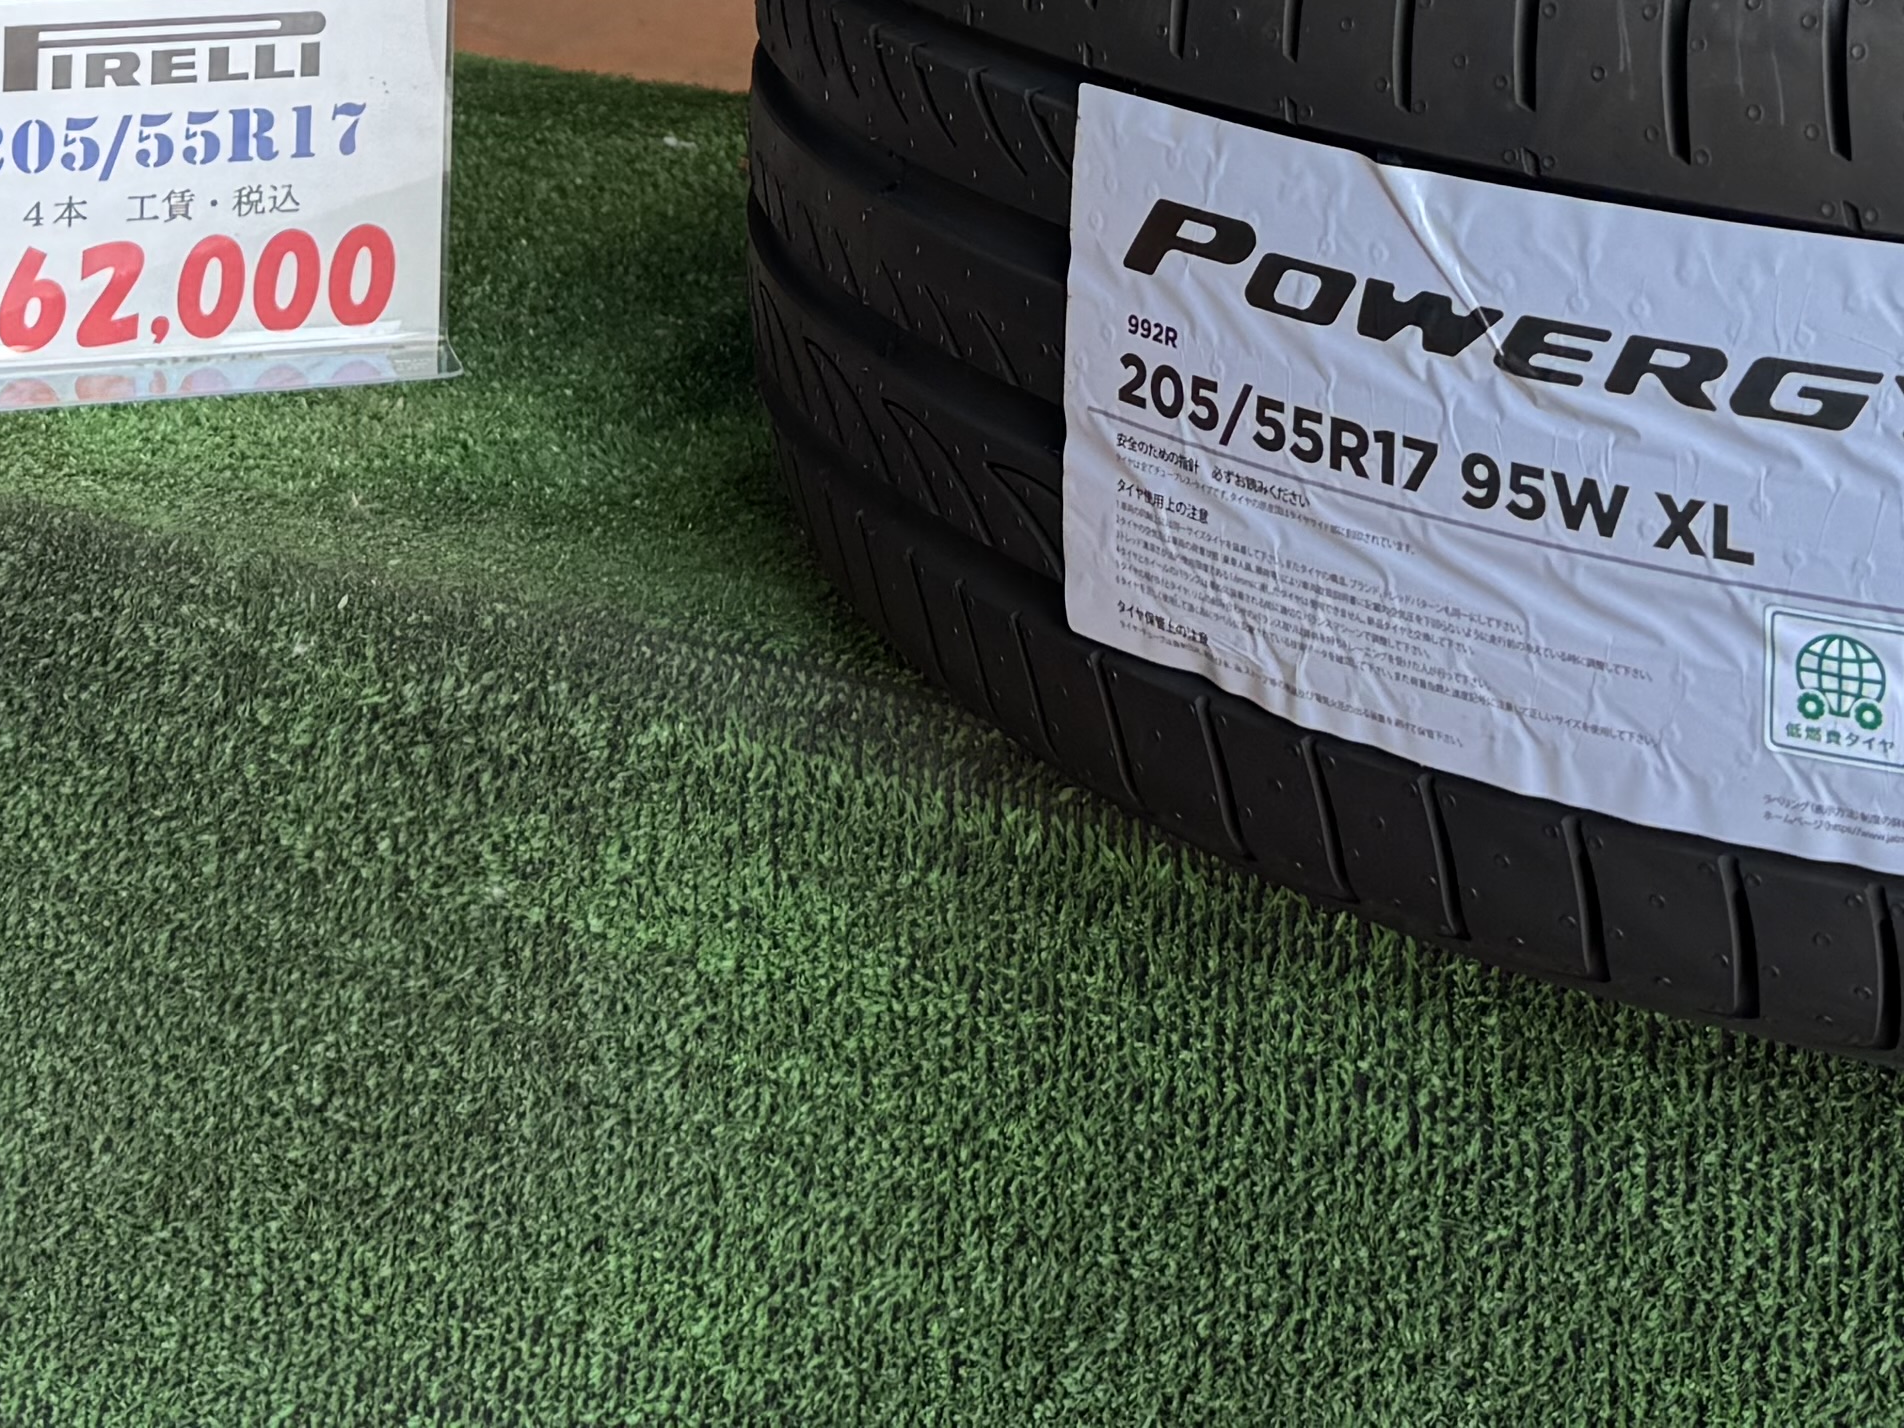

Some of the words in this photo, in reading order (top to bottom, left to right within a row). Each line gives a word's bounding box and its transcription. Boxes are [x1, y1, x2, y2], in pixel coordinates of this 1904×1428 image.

[2, 10, 326, 93] PIRELLI
[22, 196, 88, 228] 4本
[125, 185, 300, 225] 工賃・税込
[1127, 314, 1178, 349] 992R
[1116, 432, 1199, 475] 安全のための指針
[1212, 465, 1311, 508] 必ずお読みください
[1117, 353, 1439, 492] 205/55R17
[1459, 451, 1629, 539] 95W
[1652, 492, 1755, 566] XL
[1116, 477, 1209, 524] タイヤ使用上の注意
[1117, 599, 1208, 645] タイヤ保管上の注意
[1785, 721, 1896, 753] 低燃費タイヤ
